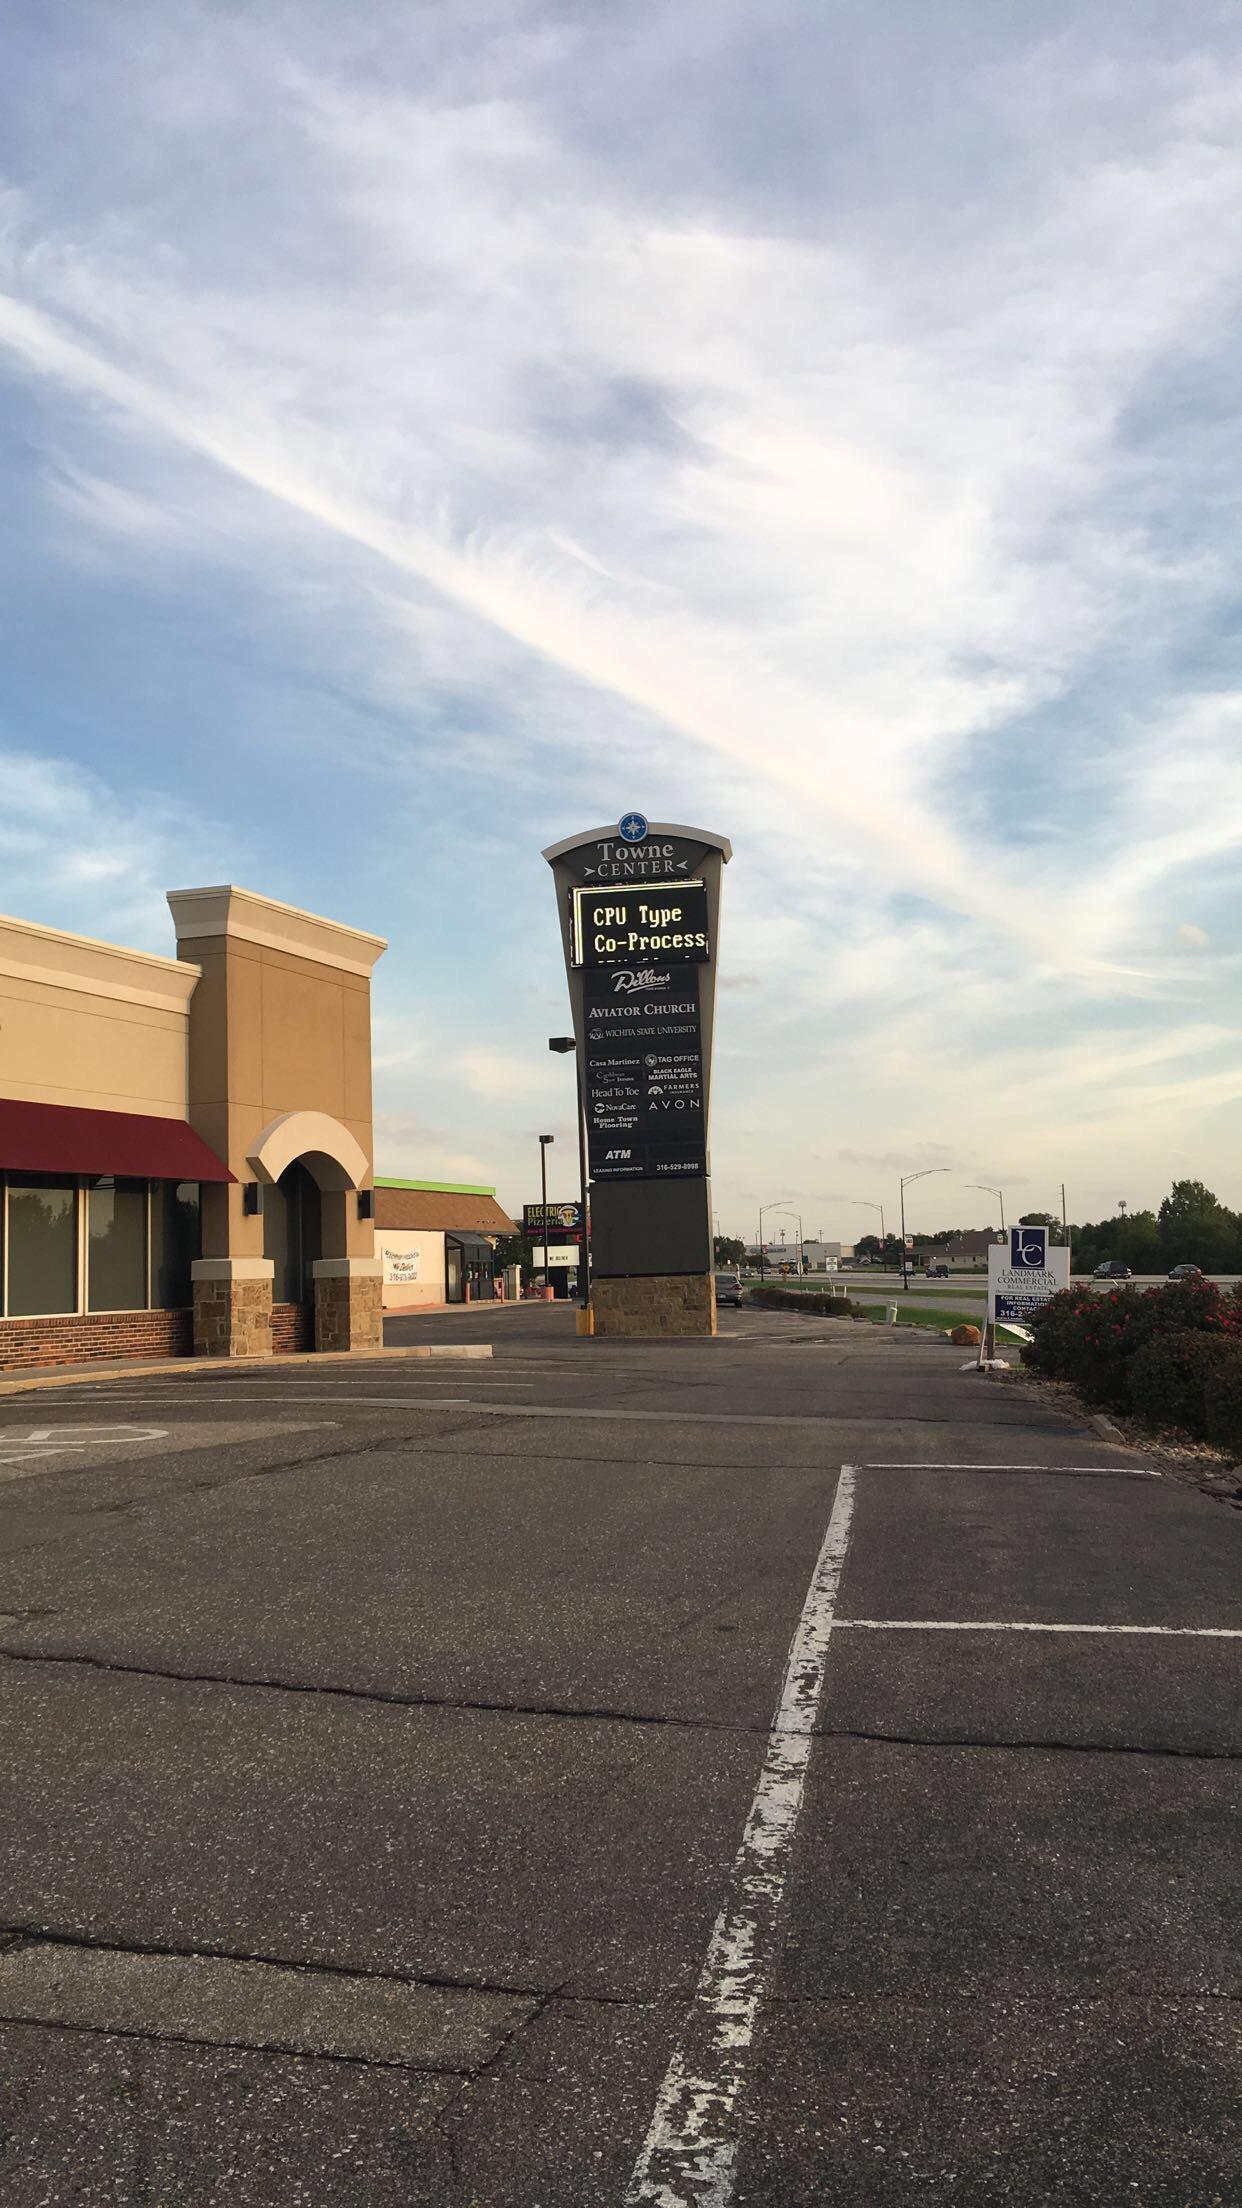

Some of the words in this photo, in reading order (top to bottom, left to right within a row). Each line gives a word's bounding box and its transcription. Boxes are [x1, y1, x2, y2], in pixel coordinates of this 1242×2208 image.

[597, 842, 674, 861] Towne
[597, 860, 675, 877] CENTER
[593, 906, 627, 926] CPU
[639, 905, 682, 928] Type
[594, 932, 705, 953] Co-Process
[611, 969, 671, 993] Dillons
[588, 1007, 641, 1018] AVIATOR
[643, 1003, 696, 1015] CHURCH
[605, 1028, 636, 1037] WICHITA
[637, 1027, 656, 1036] STATE
[657, 1025, 697, 1034] UNIVERSITY
[589, 1059, 607, 1067] Casa
[607, 1058, 640, 1066] Martinez
[673, 1054, 700, 1062] OFFICE
[648, 1073, 679, 1081] MARTIAL
[591, 1089, 613, 1098] Head
[614, 1088, 625, 1097] To
[626, 1087, 640, 1096] Toe
[605, 1103, 637, 1112] NovaCare
[648, 1098, 700, 1111] AVON
[599, 1121, 633, 1129] Flooring
[605, 1149, 632, 1160] ATM
[1002, 1269, 1055, 1279] LANDMARK
[997, 1277, 1057, 1286] COMMERCIAL
